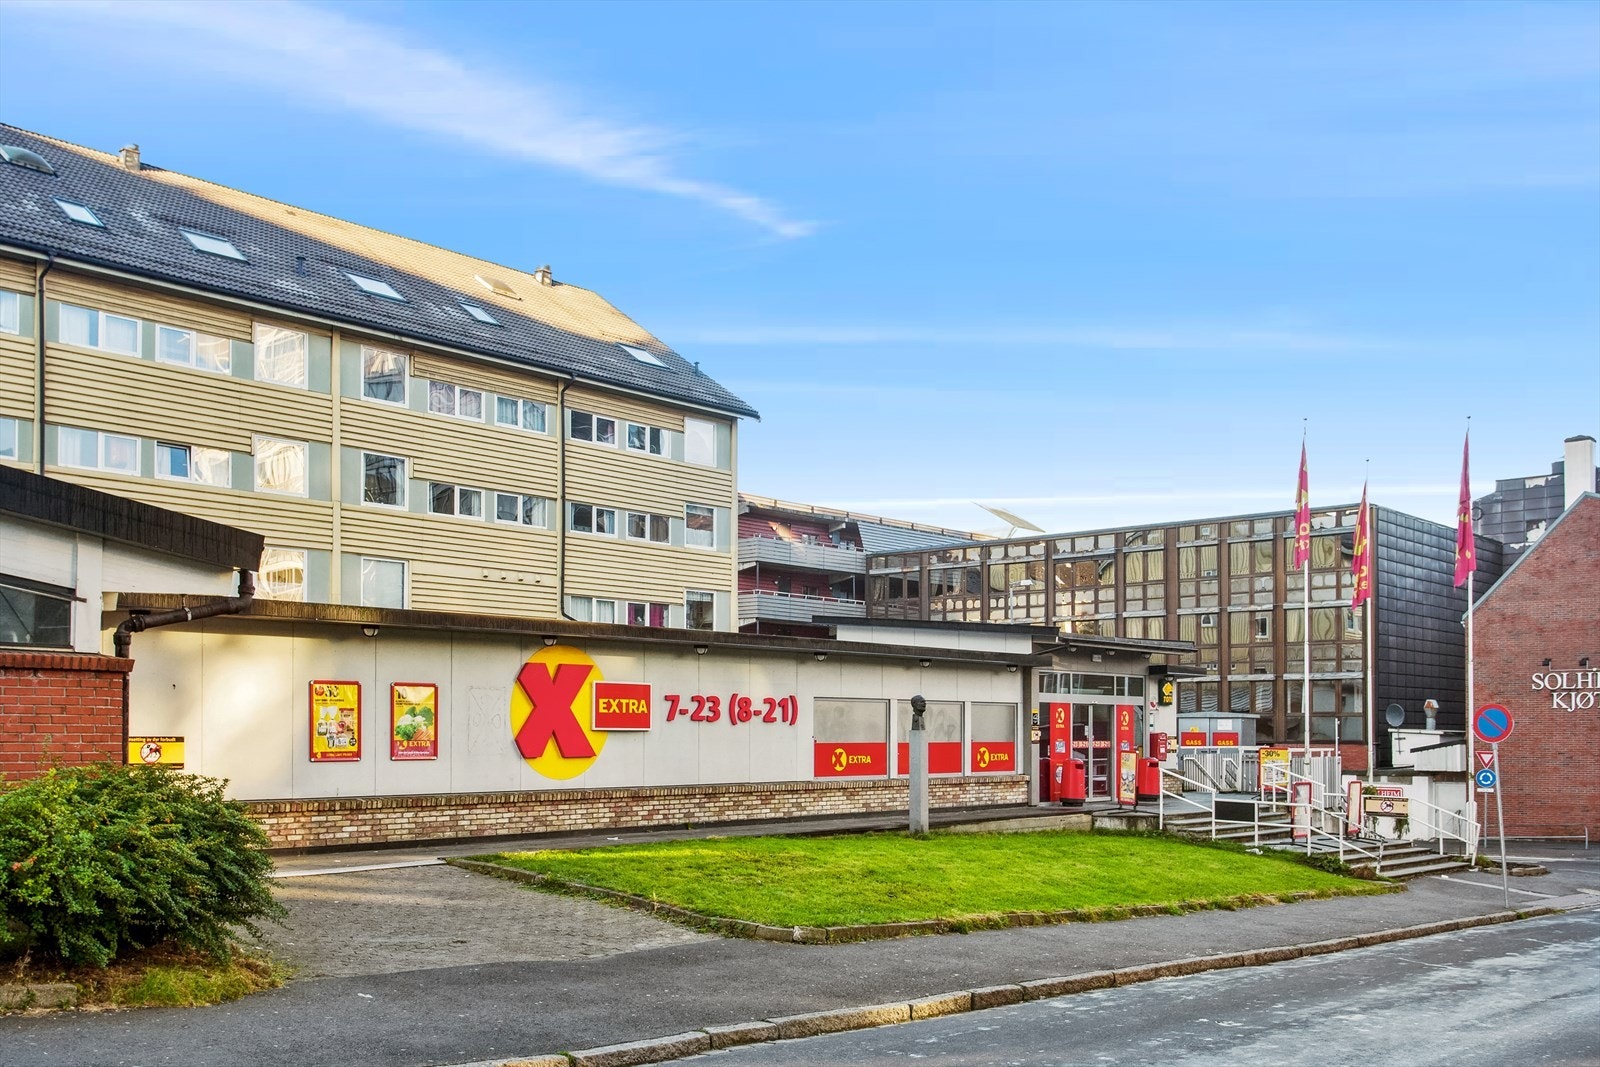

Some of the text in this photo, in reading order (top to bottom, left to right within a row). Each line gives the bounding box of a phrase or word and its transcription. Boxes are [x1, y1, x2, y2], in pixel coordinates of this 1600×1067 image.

[515, 662, 597, 759] X
[598, 698, 648, 714] EXTRA
[664, 693, 799, 726] 7-23 (8-21)
[848, 755, 872, 764] EXTRA
[990, 753, 1009, 761] EXTRA
